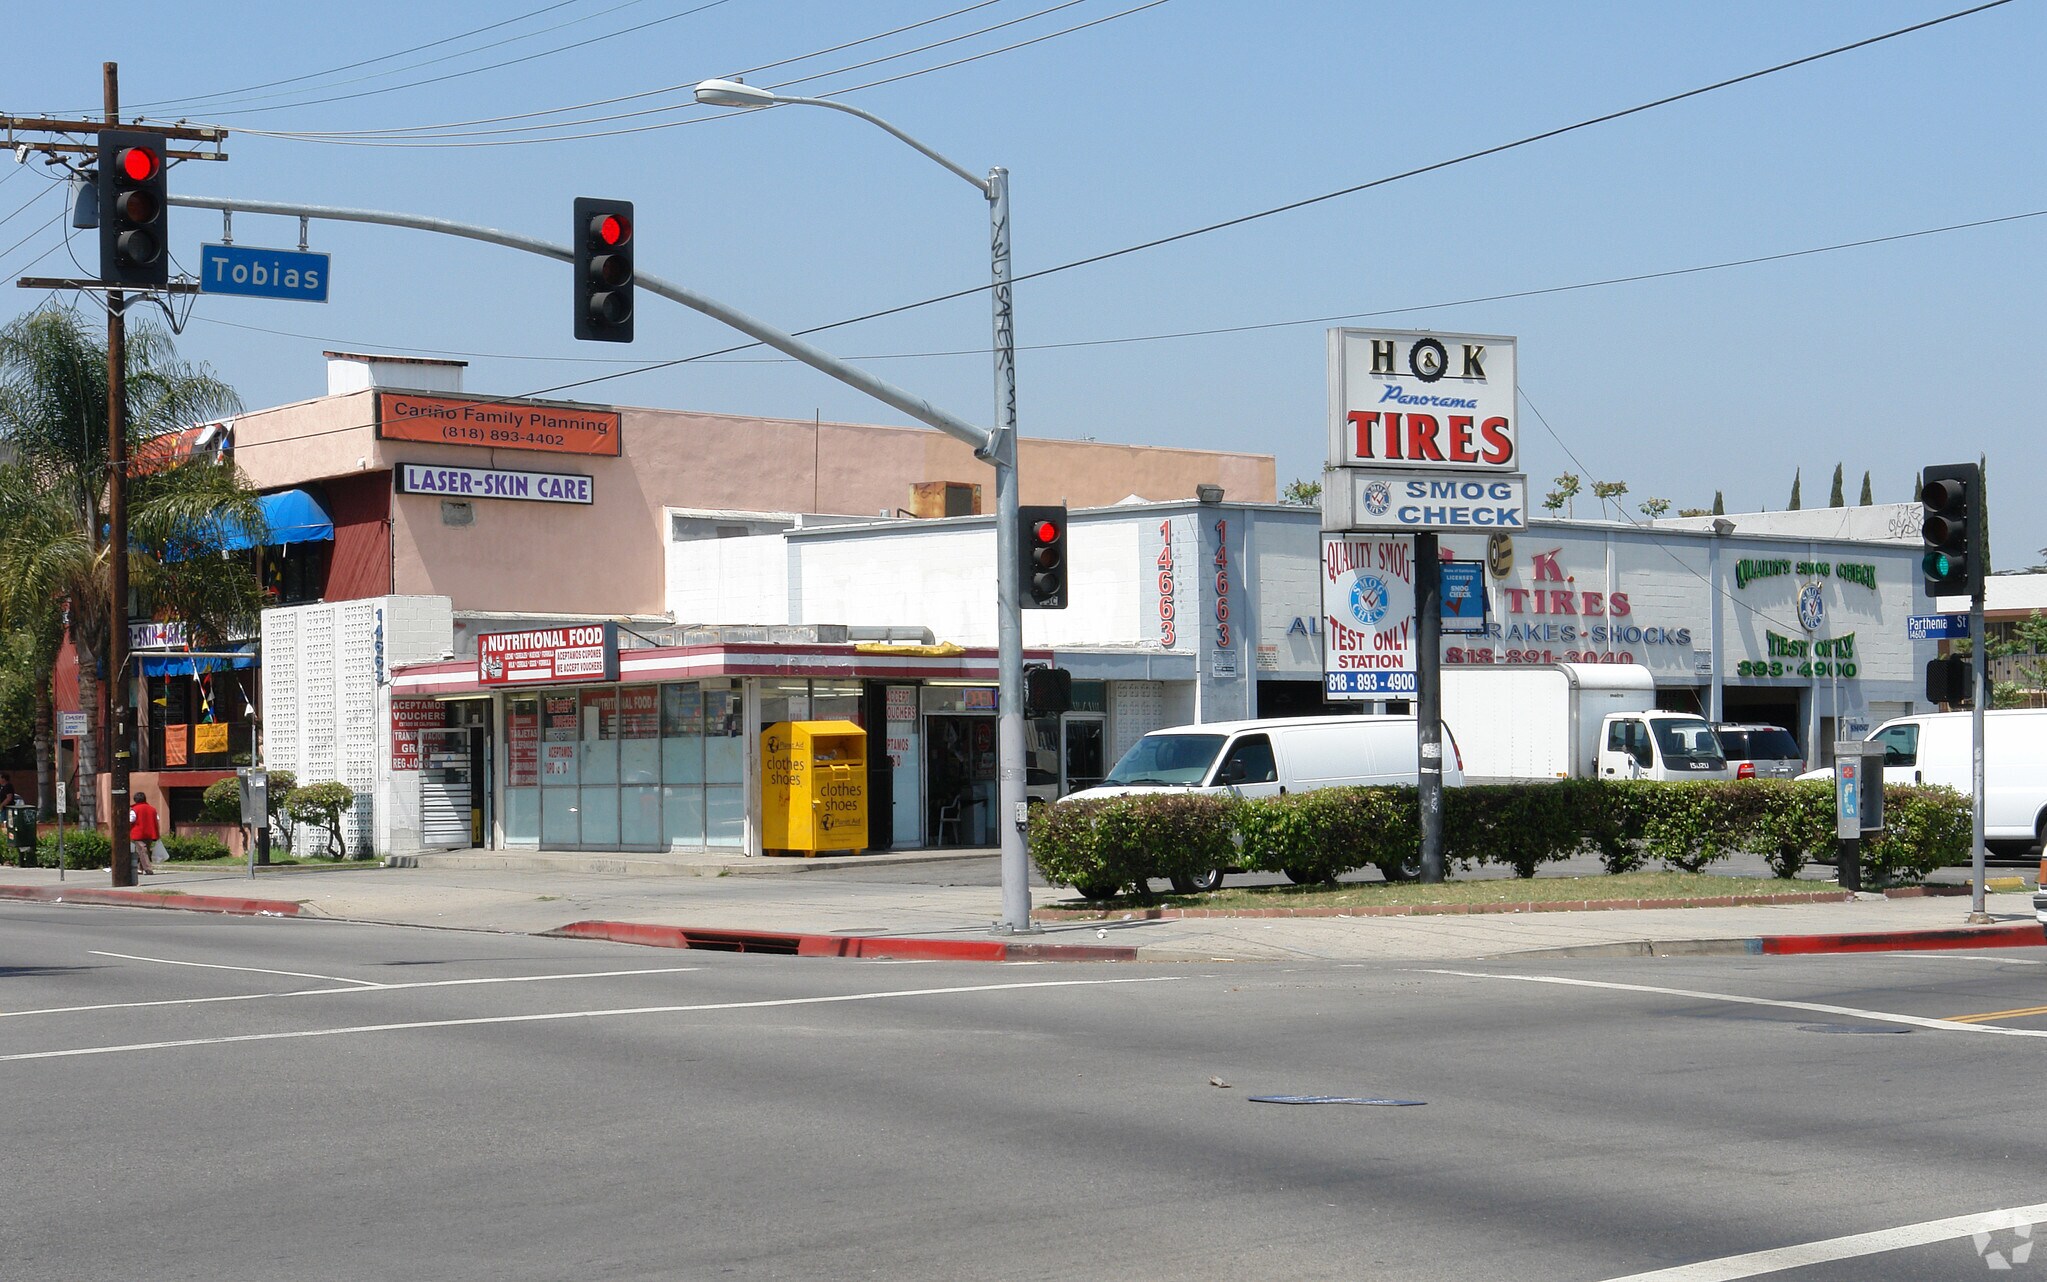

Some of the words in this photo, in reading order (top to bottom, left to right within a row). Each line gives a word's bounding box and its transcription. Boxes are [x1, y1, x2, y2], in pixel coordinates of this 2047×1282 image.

[212, 257, 318, 289] Tobias
[1369, 340, 1395, 372] H
[1422, 351, 1439, 369] &
[1461, 344, 1487, 377] K
[1378, 383, 1479, 409] Panorama
[394, 402, 457, 420] Cariño
[464, 408, 523, 428] Family
[529, 413, 608, 434] Planning
[442, 425, 485, 441] (818)
[490, 431, 564, 446] 893-4402
[1347, 410, 1514, 465] TIRES
[409, 468, 528, 497] LASER-SKIN
[537, 477, 588, 500] CARE
[1406, 481, 1512, 499] SMOG
[1397, 506, 1522, 526] CHECK
[1327, 542, 1372, 584] QUALITY
[1378, 542, 1410, 584] SMOG
[1157, 519, 1175, 648] 14663
[1215, 519, 1231, 648] 14663
[1736, 559, 1792, 589] QUALITY
[1796, 561, 1831, 577] SMOG
[1836, 562, 1877, 591] CHECK
[1353, 578, 1384, 596] SMOG
[1352, 603, 1387, 623] CHECK
[1504, 588, 1632, 618] TIRES
[1909, 617, 1948, 630] Parthenia
[1956, 615, 1967, 628] St
[488, 630, 567, 652] NUTRITIONAL
[569, 627, 603, 646] FOOD
[1329, 615, 1365, 651] TEST
[1374, 616, 1409, 651] ONLY
[1591, 625, 1692, 646] SHOCKS
[1909, 630, 1927, 639] 14600
[1766, 629, 1809, 658] TEST
[1338, 655, 1404, 669] STATION
[393, 701, 446, 710] ACEPTAMOS
[965, 690, 994, 706] OPEN
[393, 712, 446, 720] VOUCHERS
[887, 706, 916, 719] OUCHERS
[395, 731, 446, 741] TRANSPTACION
[1850, 723, 1869, 732] SMOG
[401, 743, 439, 753] GRTIS
[767, 756, 805, 772] clothes
[771, 771, 801, 786] shoes
[821, 782, 862, 797] clothes
[825, 797, 857, 812] shoes
